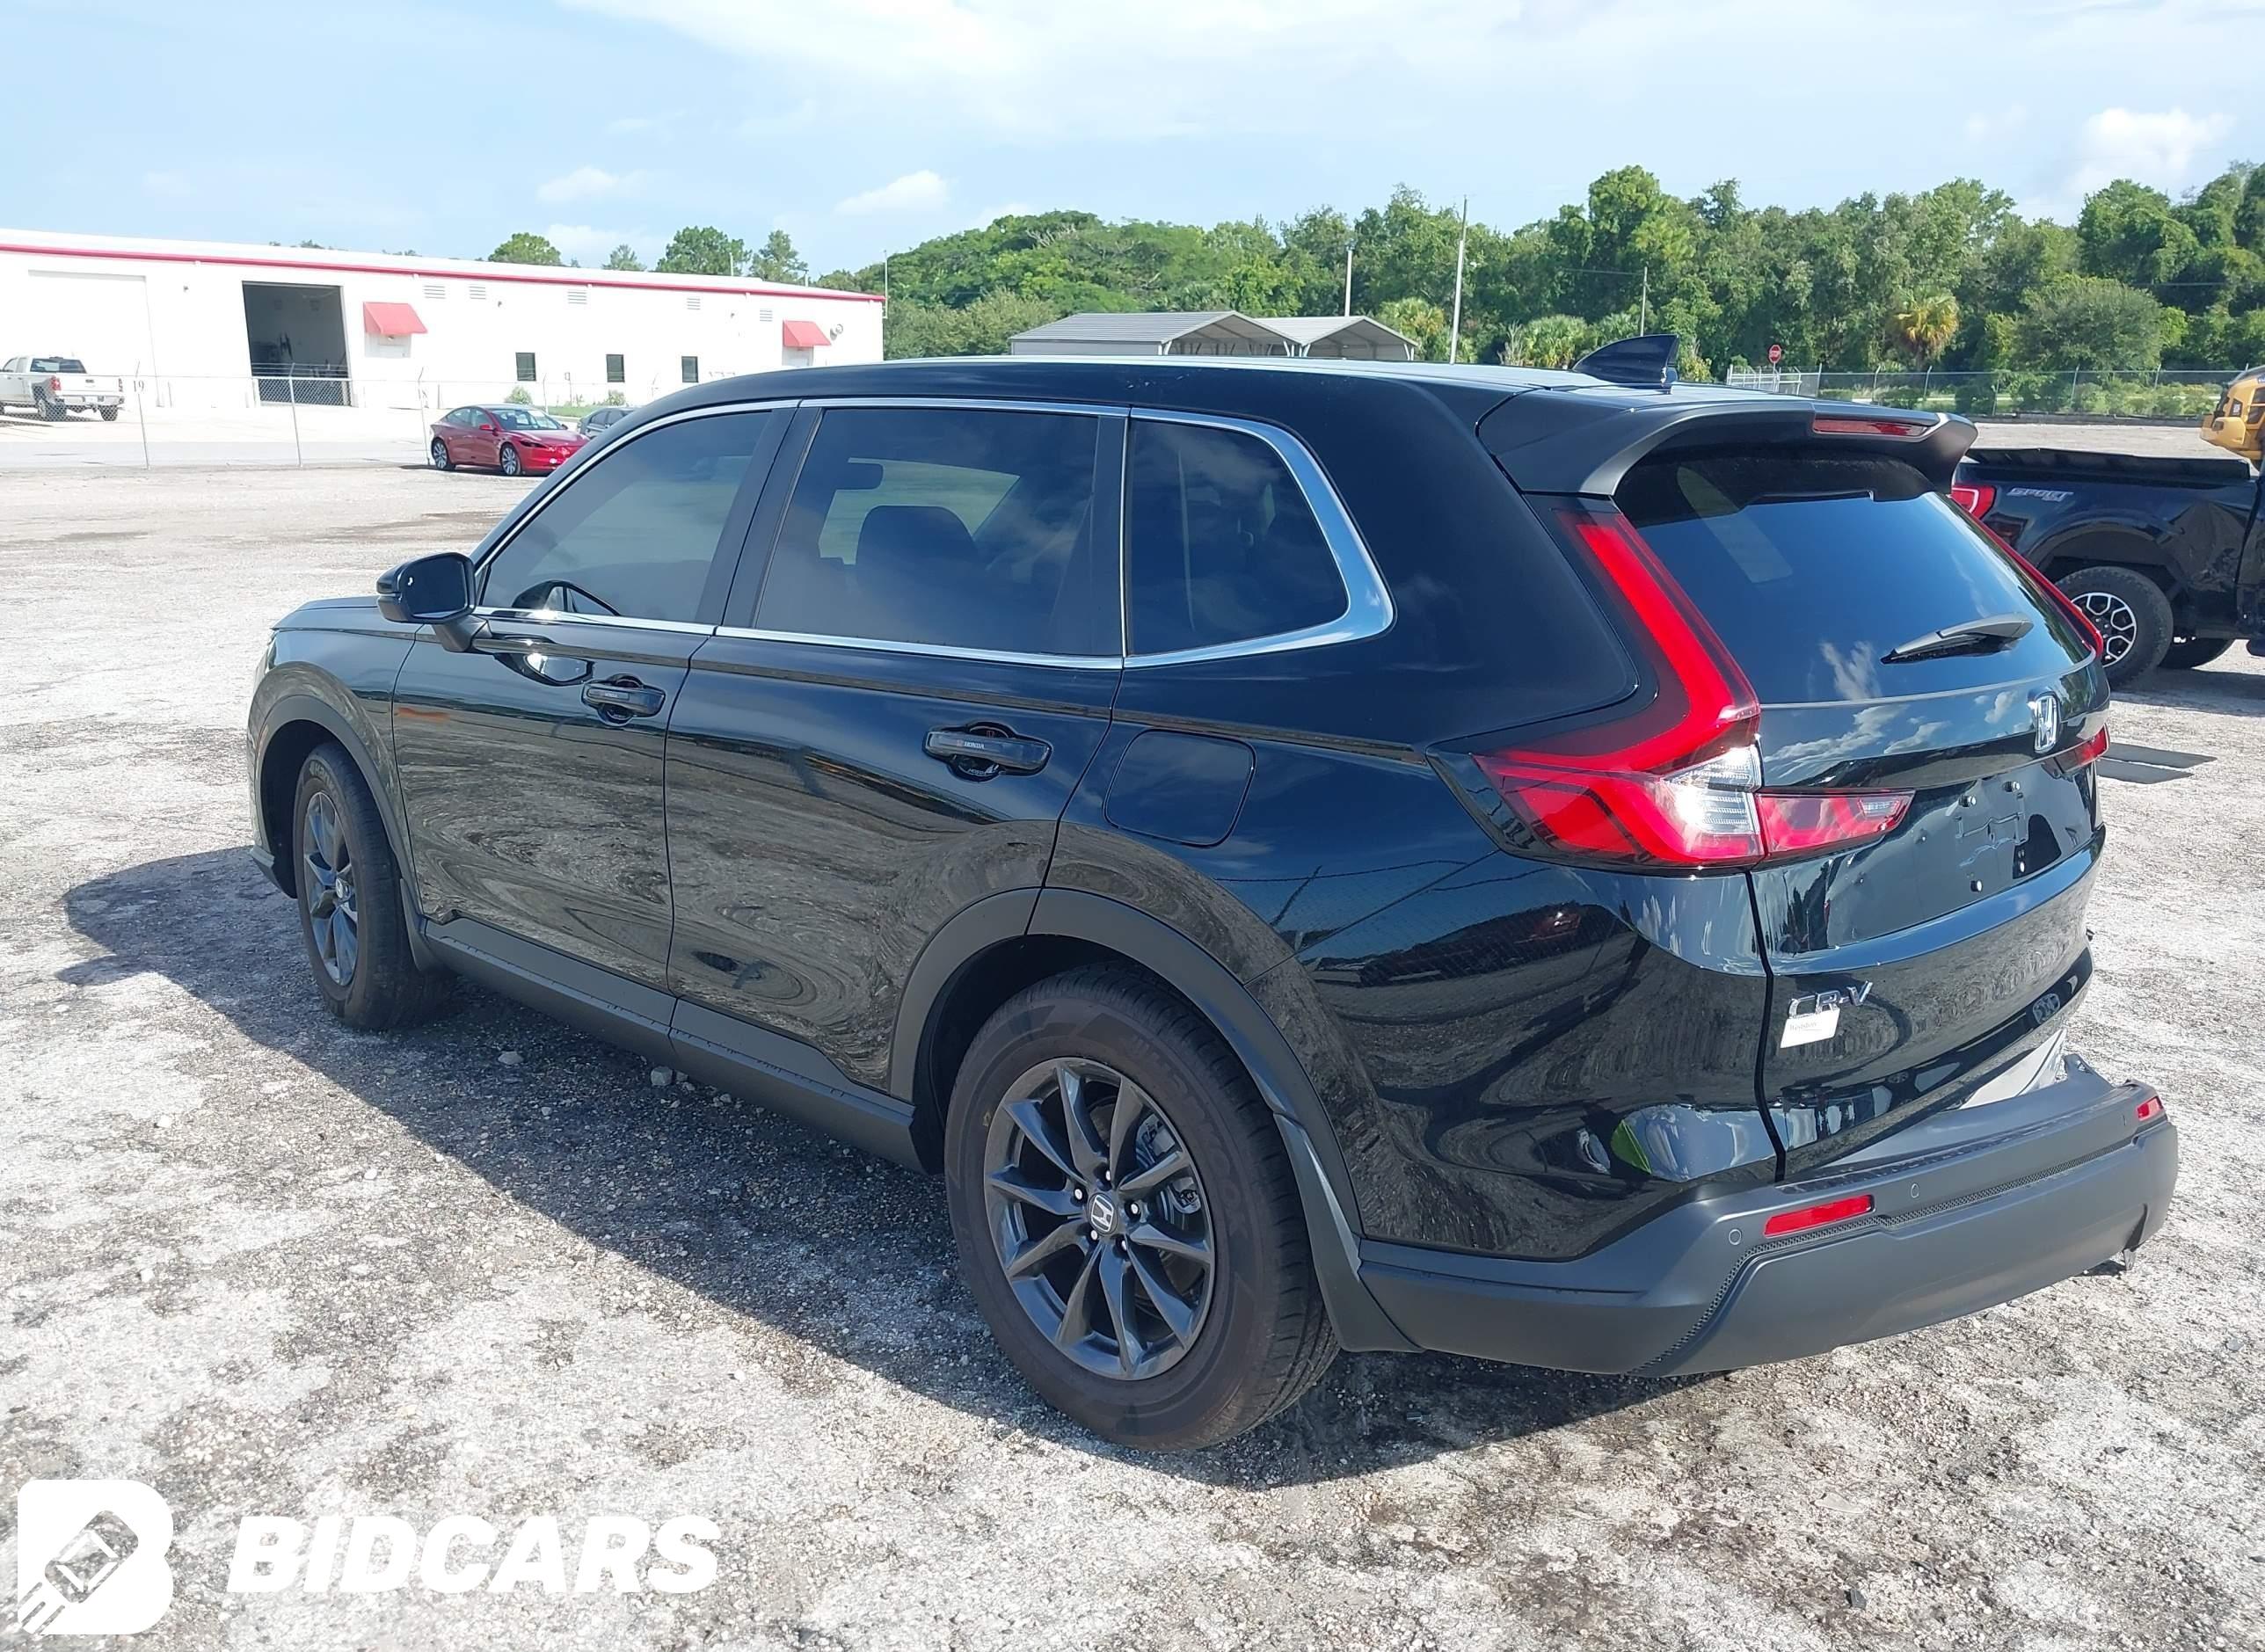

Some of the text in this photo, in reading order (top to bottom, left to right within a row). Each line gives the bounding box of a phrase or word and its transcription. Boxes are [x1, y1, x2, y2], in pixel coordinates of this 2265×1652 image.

[2006, 487, 2074, 502] SPORT
[964, 740, 985, 749] HONDA
[1788, 979, 1874, 1019] CR-V
